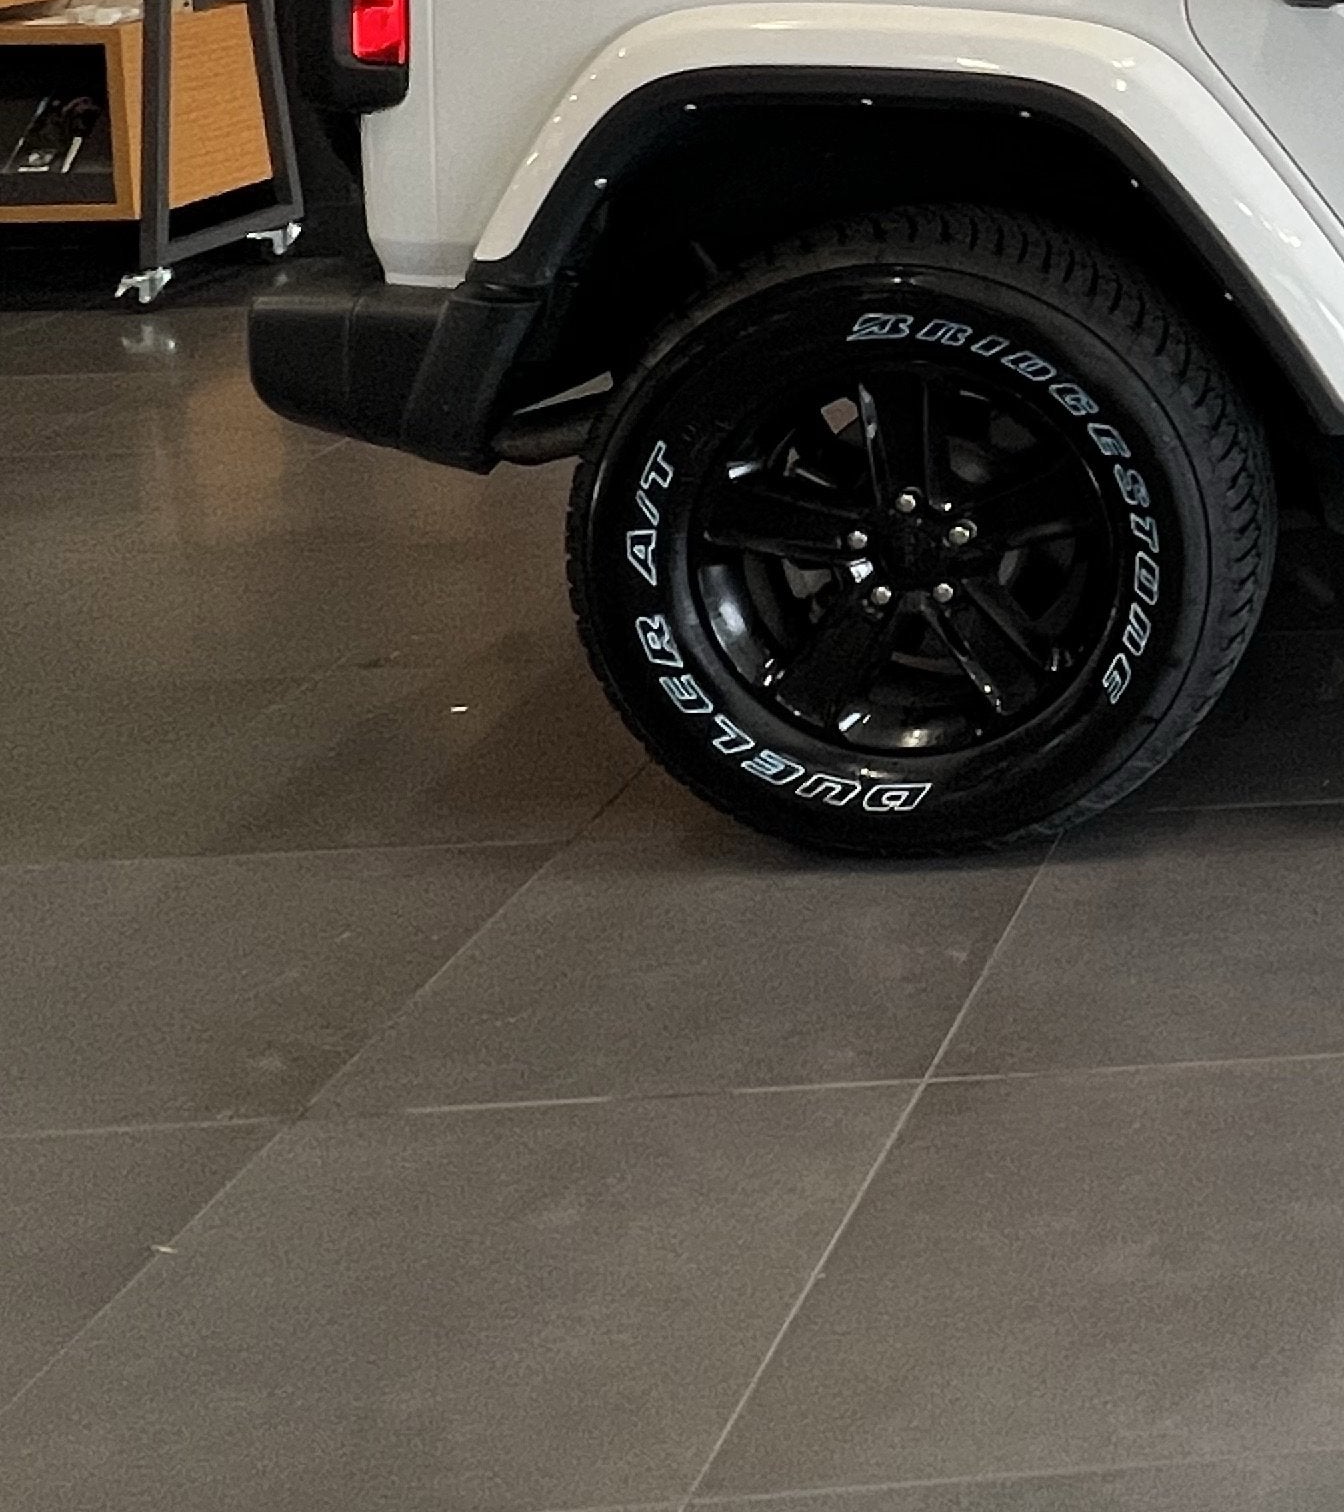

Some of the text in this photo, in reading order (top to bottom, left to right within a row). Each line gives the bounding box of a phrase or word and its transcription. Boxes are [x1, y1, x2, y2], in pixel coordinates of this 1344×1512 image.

[626, 439, 932, 812] DUELER A/T
[846, 312, 1162, 704] BRIDGESTONE
